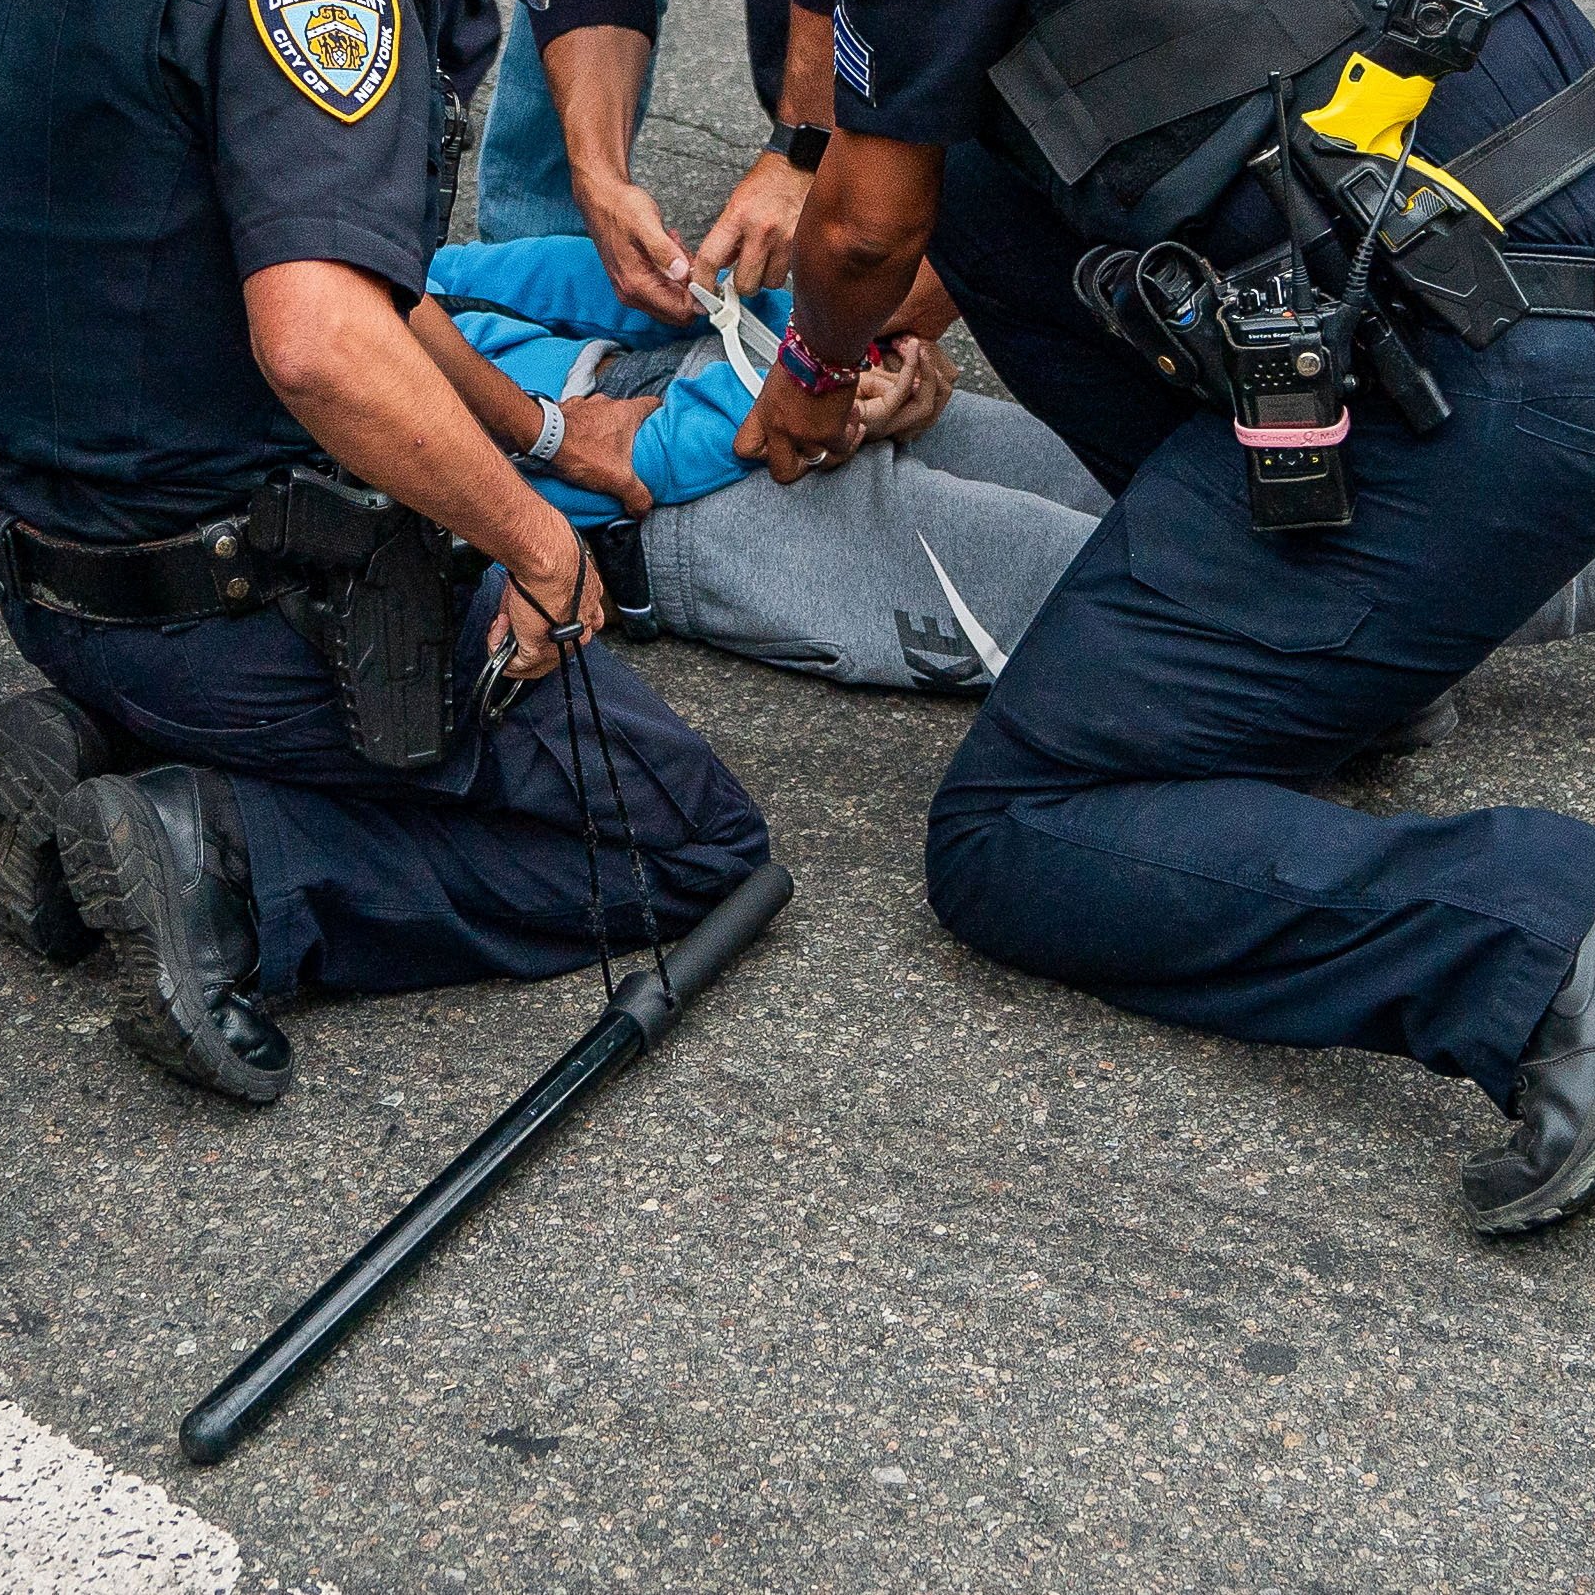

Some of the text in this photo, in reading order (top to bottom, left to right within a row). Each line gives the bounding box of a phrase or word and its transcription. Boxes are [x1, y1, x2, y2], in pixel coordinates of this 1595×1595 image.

[272, 28, 330, 94] CITY OF
[354, 25, 394, 105] NEW YORK
[1260, 433, 1293, 442] Cancer
